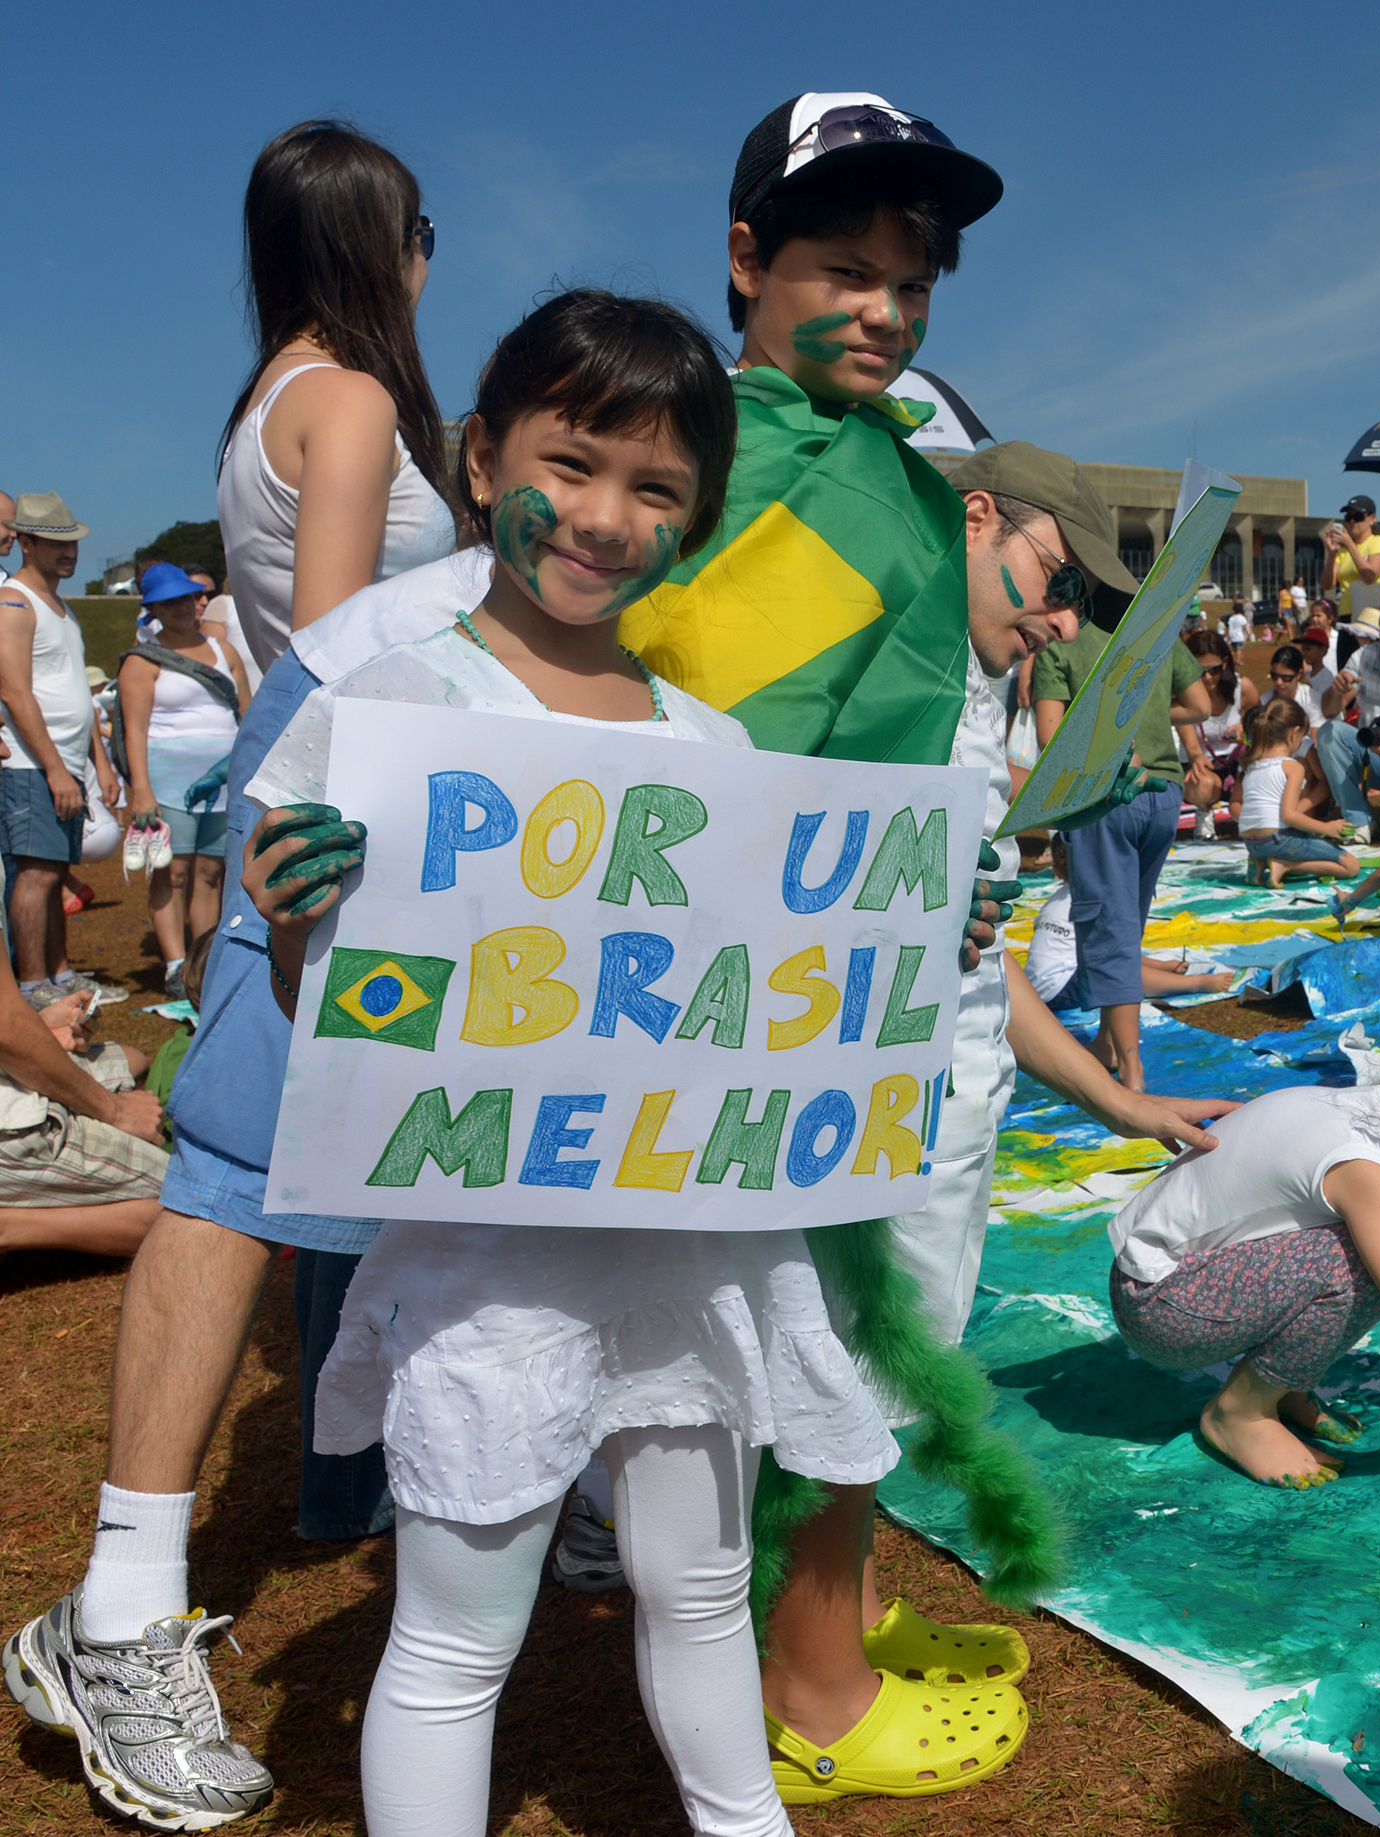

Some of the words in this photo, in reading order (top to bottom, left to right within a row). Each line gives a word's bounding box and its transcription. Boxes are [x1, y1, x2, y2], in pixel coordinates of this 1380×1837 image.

[420, 770, 709, 907] POR
[781, 805, 948, 914] UM
[459, 925, 941, 1051] BRASIL
